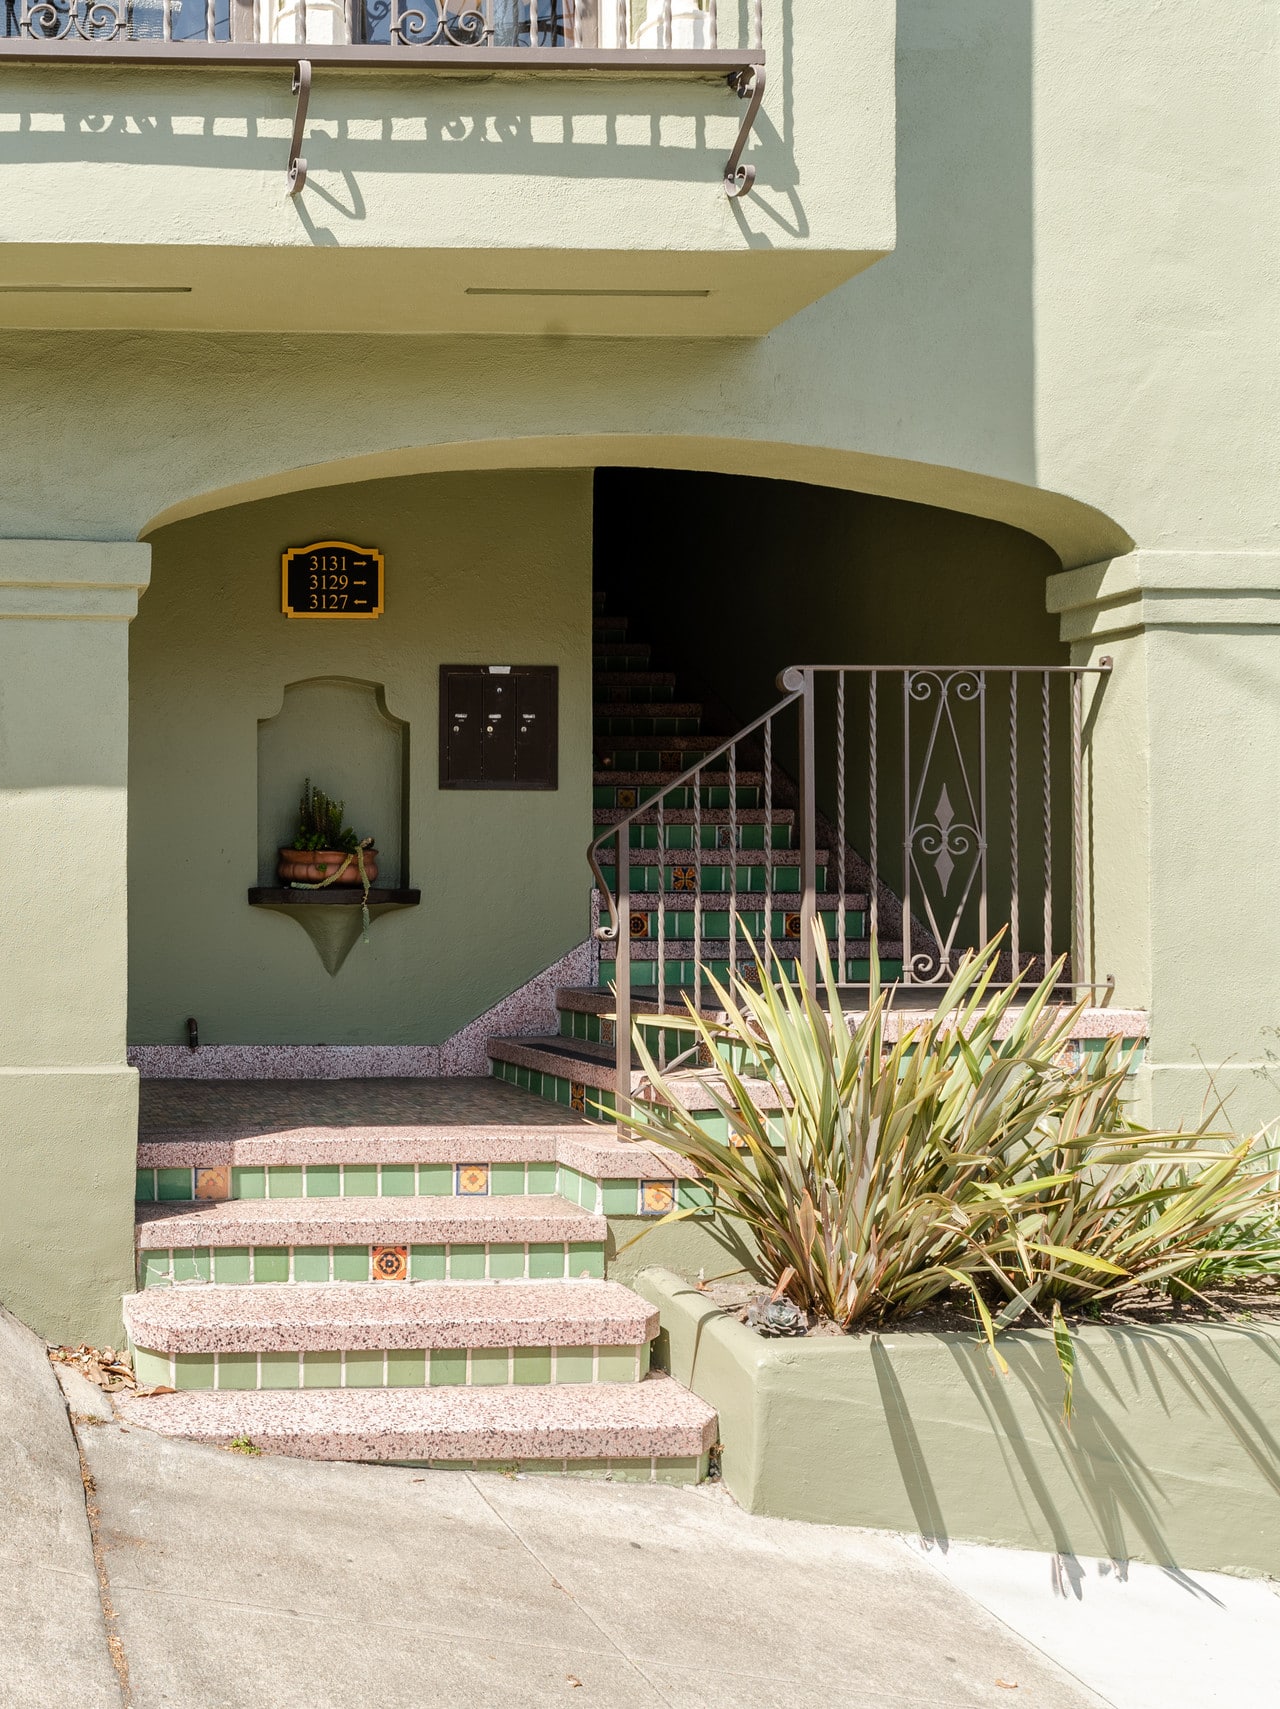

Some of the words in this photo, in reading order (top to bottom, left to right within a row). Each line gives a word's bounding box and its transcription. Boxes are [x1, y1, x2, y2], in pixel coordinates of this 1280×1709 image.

[309, 556, 347, 571] 3131
[309, 575, 349, 590] 3129
[309, 594, 349, 609] 3127
